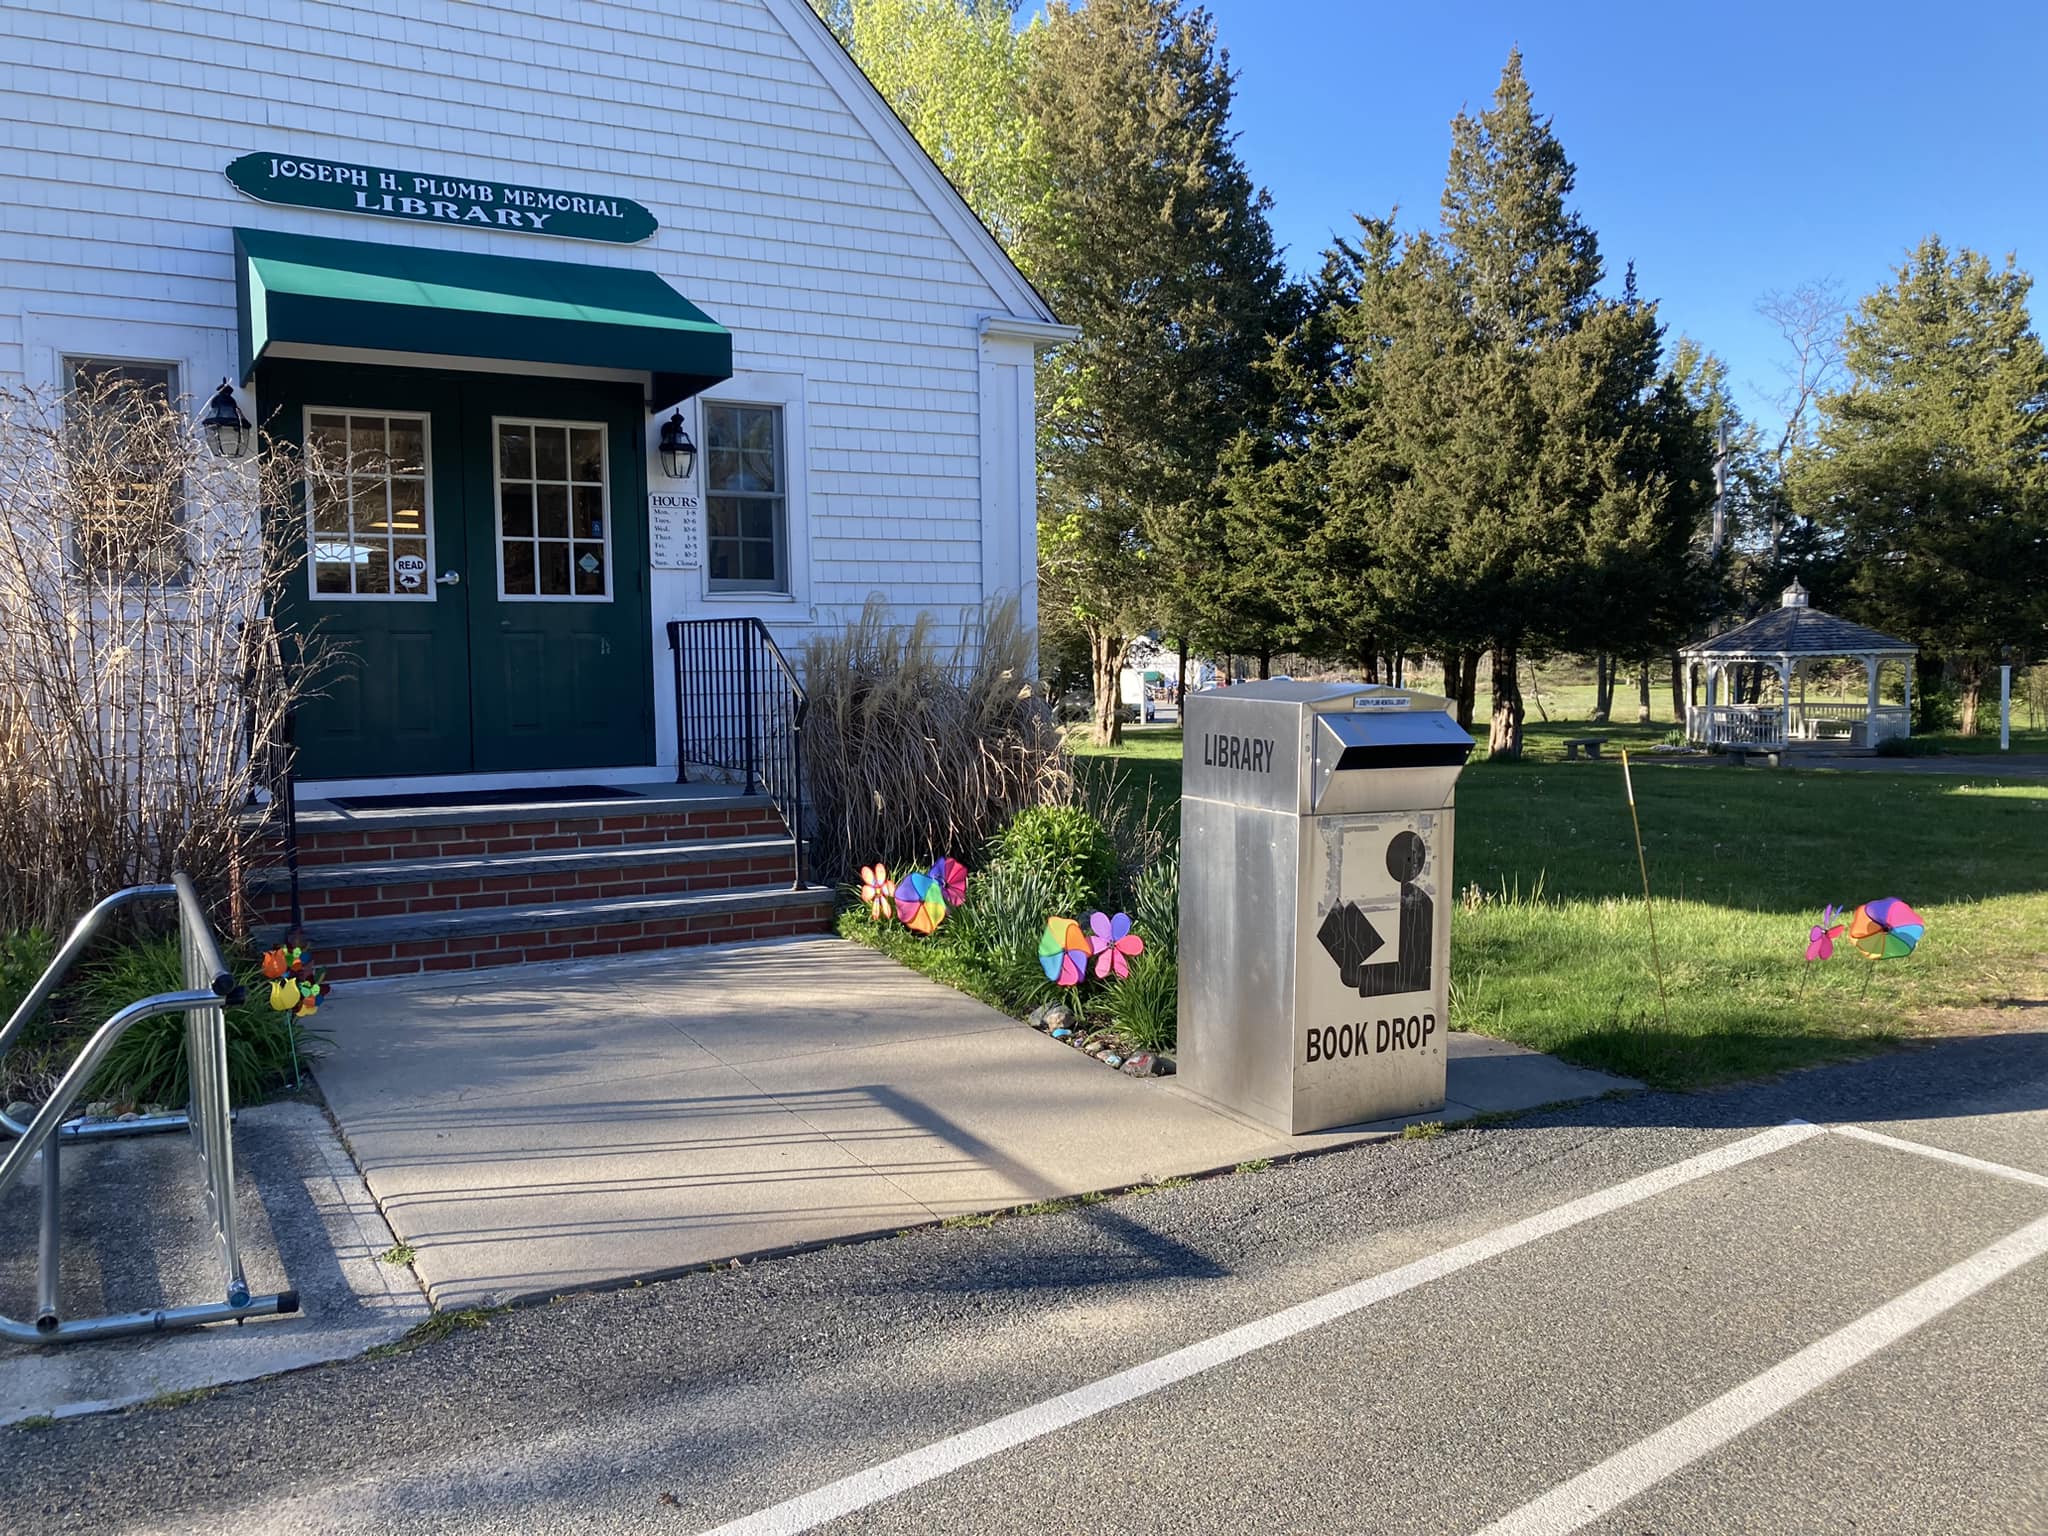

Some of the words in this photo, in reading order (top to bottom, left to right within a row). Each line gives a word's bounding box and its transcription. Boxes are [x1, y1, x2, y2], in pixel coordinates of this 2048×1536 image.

[269, 159, 368, 187] JOSEPH
[379, 173, 402, 191] H.
[413, 177, 494, 202] PLUMB
[504, 188, 623, 218] MEMORIAL
[354, 191, 551, 229] LIBRARY
[652, 496, 698, 507] HOURS
[398, 560, 424, 570] READ
[1205, 733, 1274, 773] LIBRARY
[1306, 1022, 1369, 1062] BOOK
[1376, 1014, 1436, 1053] DROP
